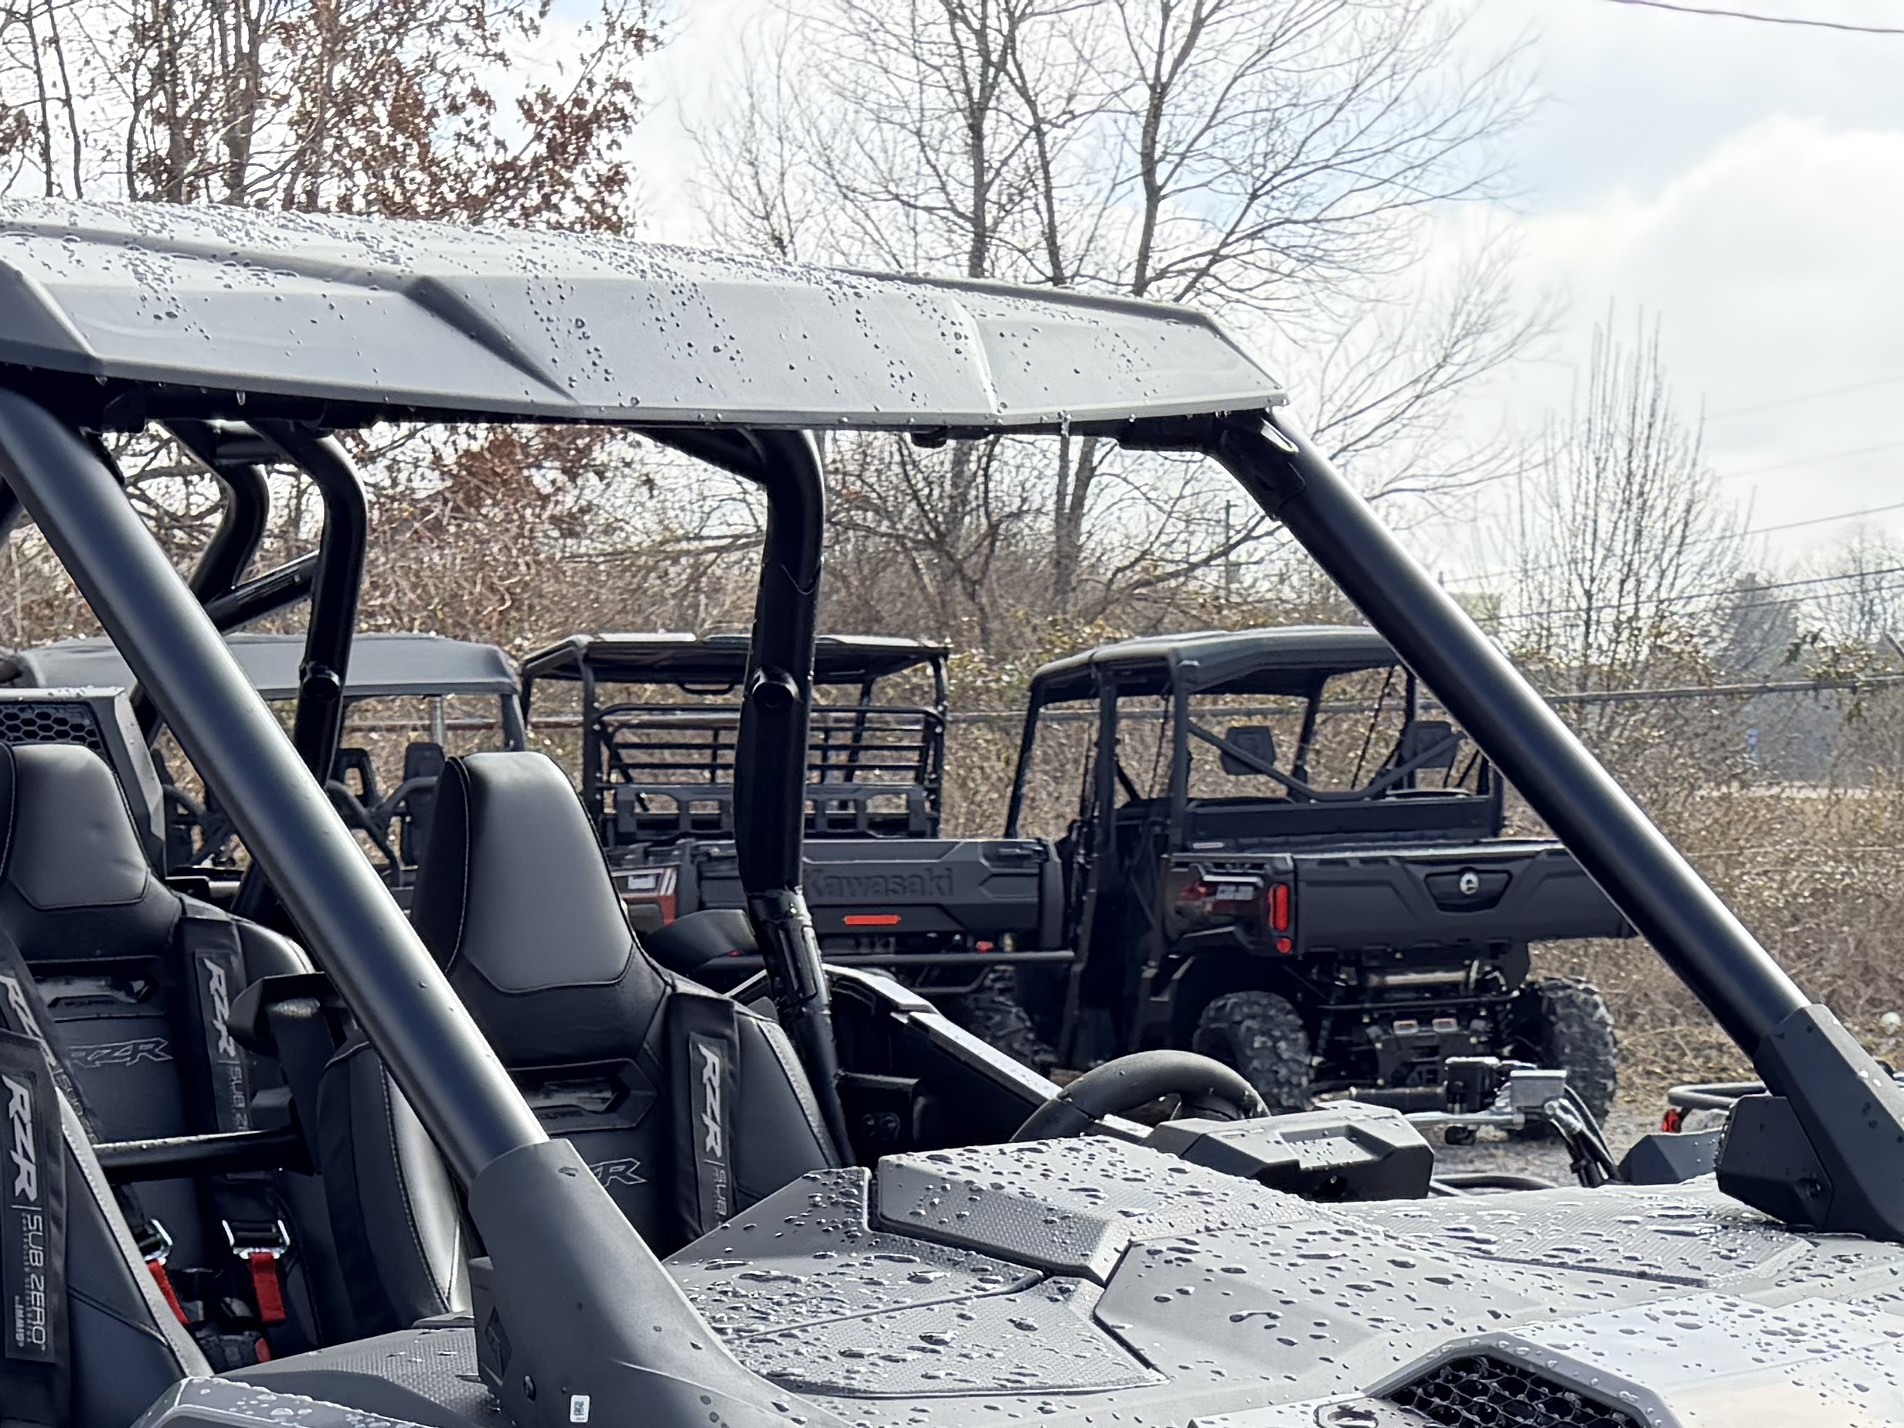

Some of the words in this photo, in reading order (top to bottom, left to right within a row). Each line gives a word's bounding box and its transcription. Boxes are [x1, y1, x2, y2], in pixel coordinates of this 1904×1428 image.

[803, 867, 955, 897] Kawasaki
[204, 957, 236, 1057] RZR
[2, 1074, 38, 1202] RZR
[698, 1044, 723, 1159] RZR
[27, 1215, 44, 1267] SUB
[30, 1275, 46, 1345] ZERO
